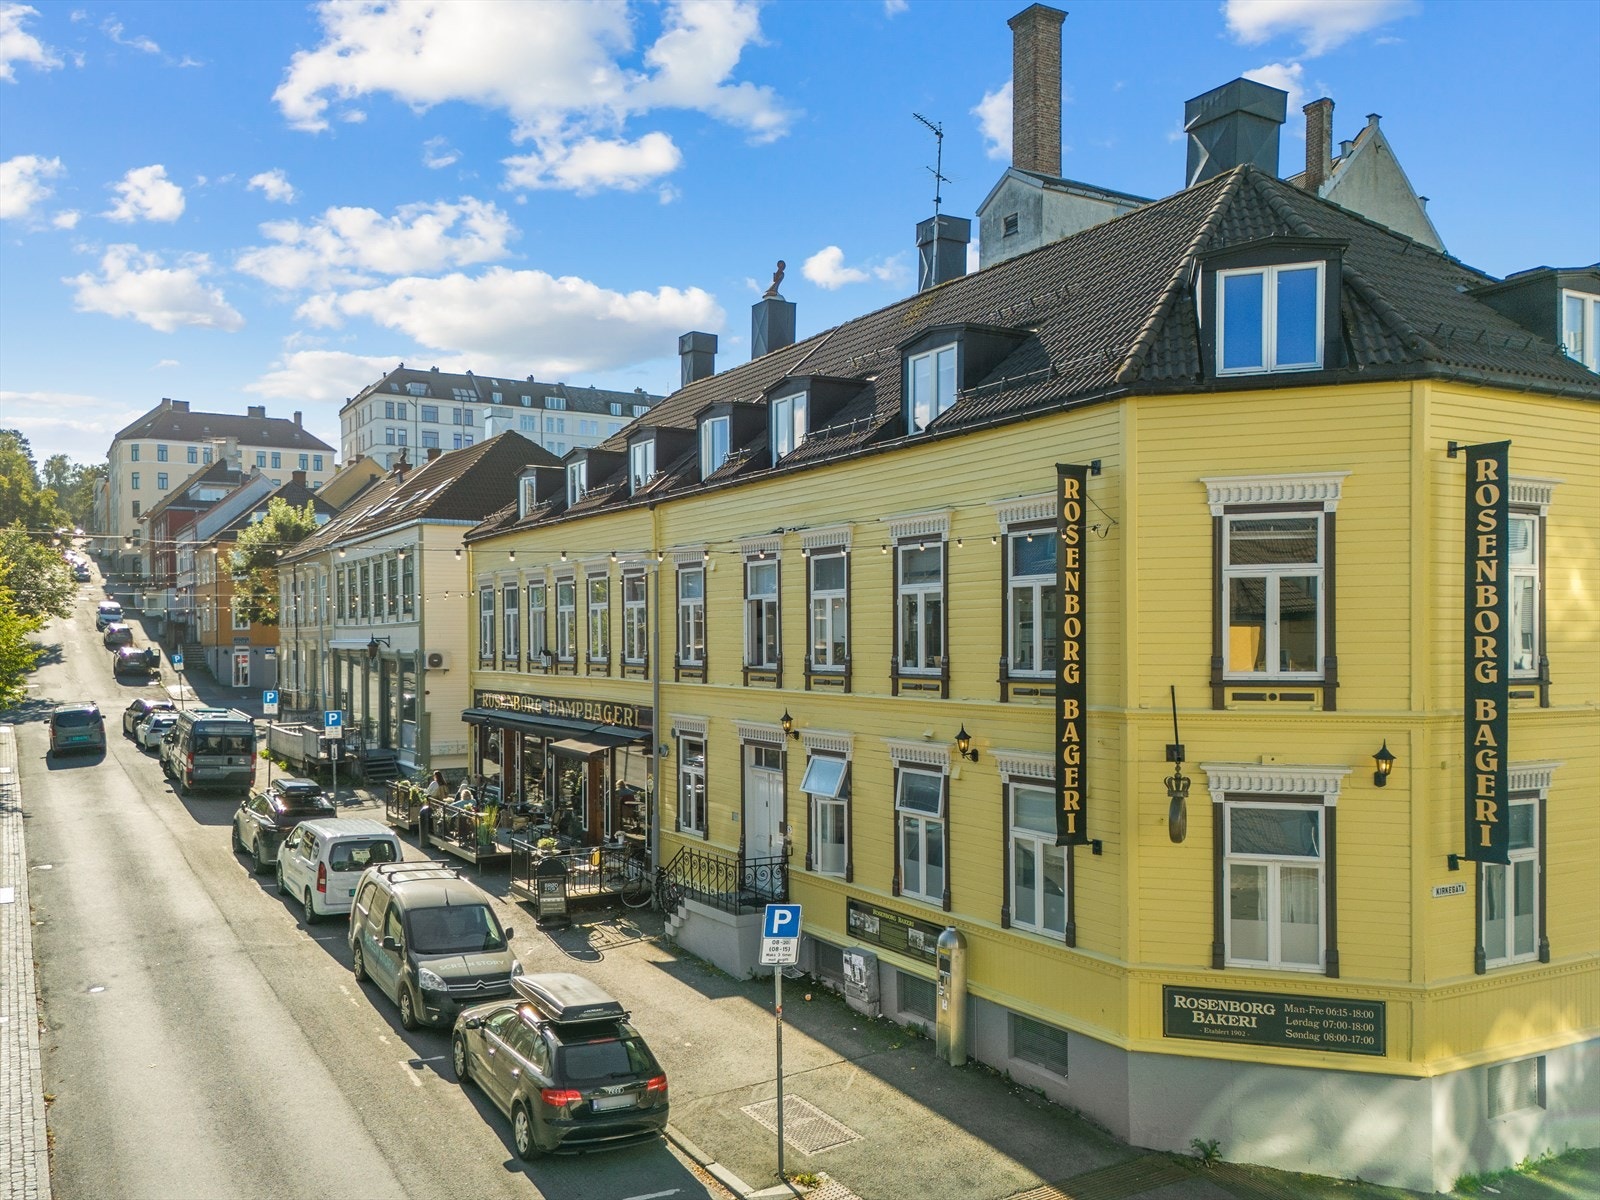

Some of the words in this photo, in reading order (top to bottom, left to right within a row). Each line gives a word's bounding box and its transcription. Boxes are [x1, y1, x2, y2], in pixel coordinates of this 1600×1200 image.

[1063, 477, 1081, 684] ROSENBORG
[1474, 459, 1500, 684] ROSENBORG
[266, 692, 275, 702] P
[328, 713, 338, 725] P
[482, 692, 542, 714] ROSENBORG
[549, 699, 640, 727] DAMPBAGERI
[1062, 699, 1080, 833] BAGERI
[1475, 698, 1498, 847] BAGERI
[772, 909, 792, 934] P
[1174, 995, 1276, 1015] ROSENBORG
[1284, 1003, 1325, 1015] Man-Fre
[1192, 1010, 1257, 1028] BAKERI
[1285, 1016, 1321, 1029] Lørdag
[1203, 1027, 1230, 1036] Etablert
[1231, 1029, 1247, 1037] 1902
[1285, 1029, 1321, 1043] Søndag
